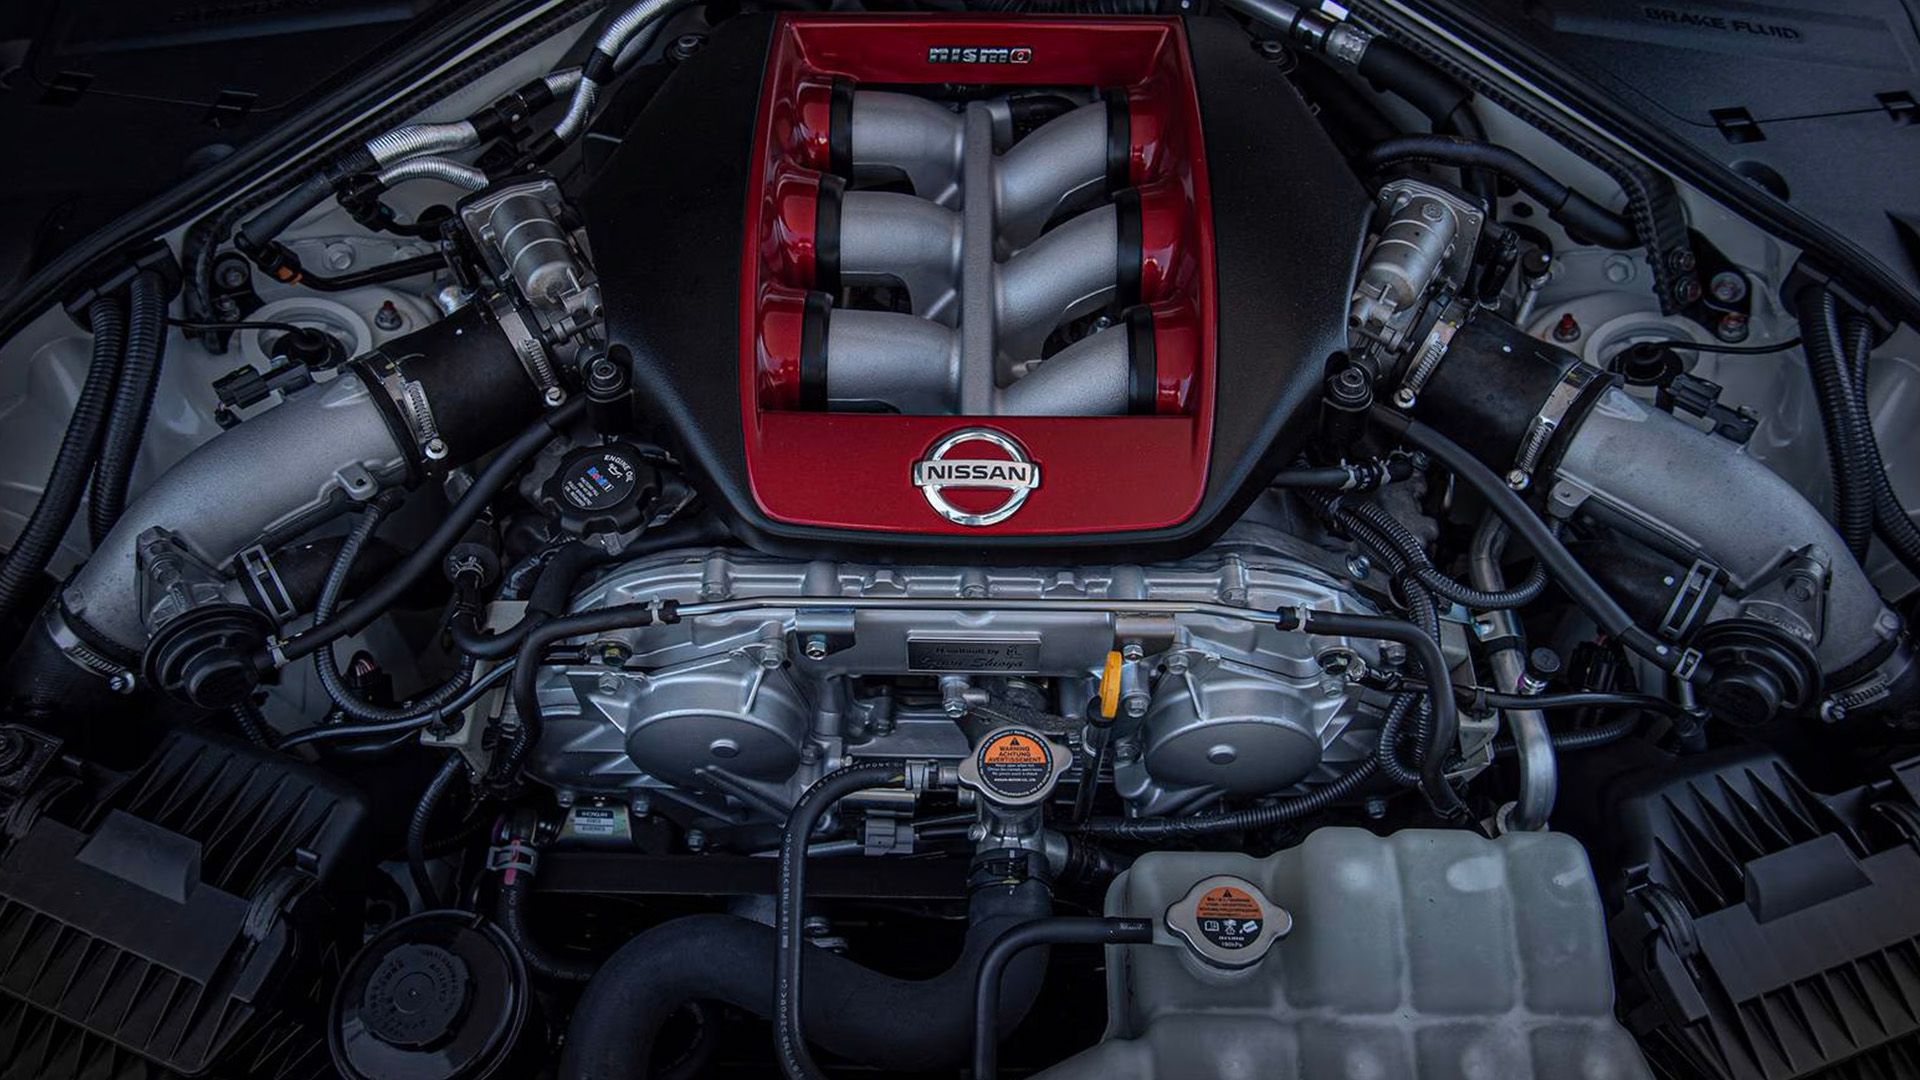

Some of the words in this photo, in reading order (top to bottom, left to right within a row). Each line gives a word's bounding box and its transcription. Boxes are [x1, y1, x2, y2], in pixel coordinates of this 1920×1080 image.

[1644, 7, 1727, 30] BRAKE
[1731, 19, 1801, 39] FLUID
[604, 454, 631, 471] ENGINE
[927, 464, 1027, 481] NISSAN
